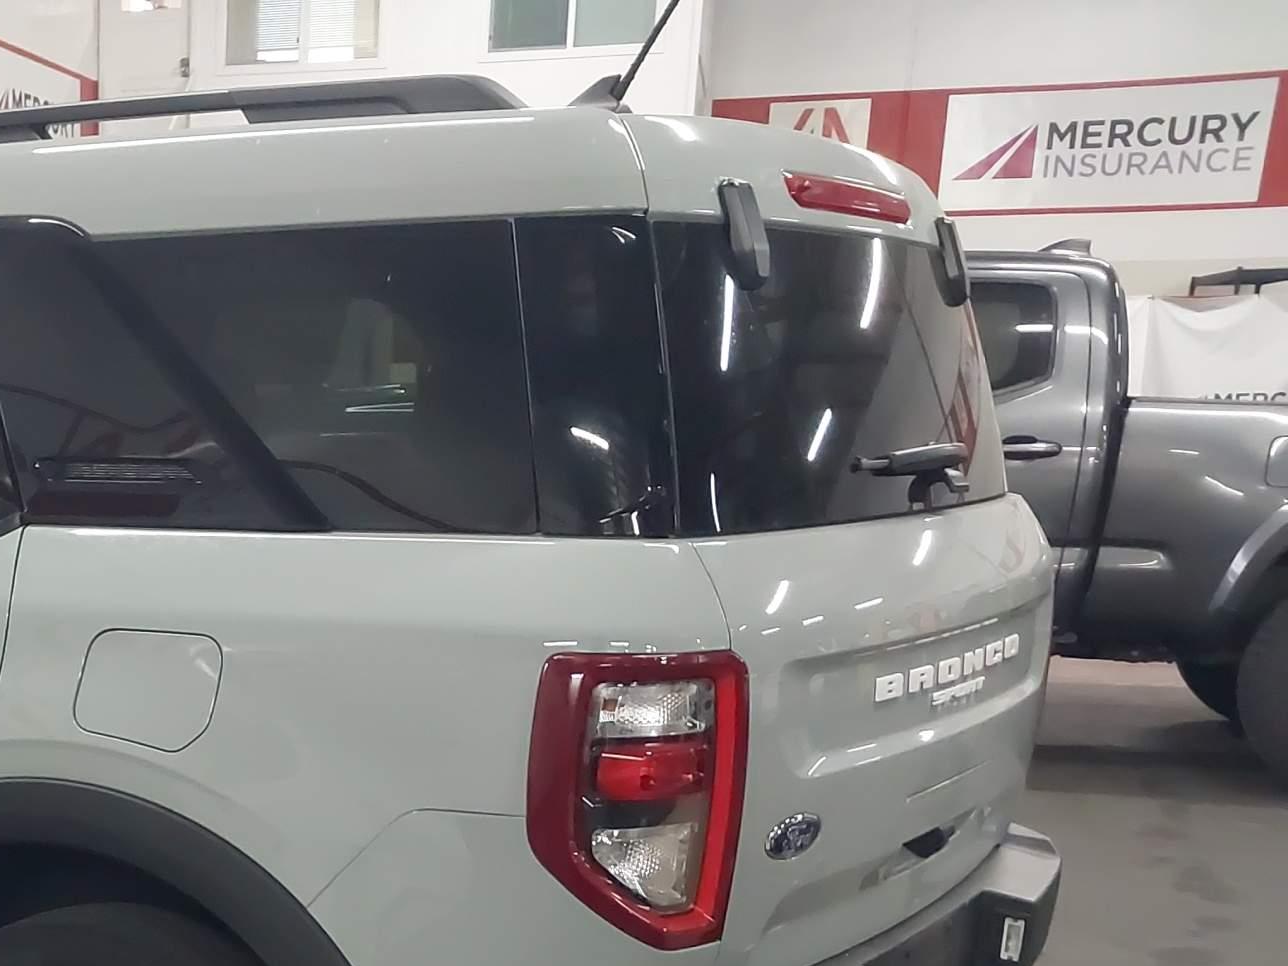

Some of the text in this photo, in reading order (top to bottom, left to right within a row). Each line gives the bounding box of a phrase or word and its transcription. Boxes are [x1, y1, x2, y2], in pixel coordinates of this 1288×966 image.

[1045, 110, 1262, 151] MERCURY
[1042, 146, 1255, 179] INSURANCE
[874, 632, 1020, 703] BRONCO
